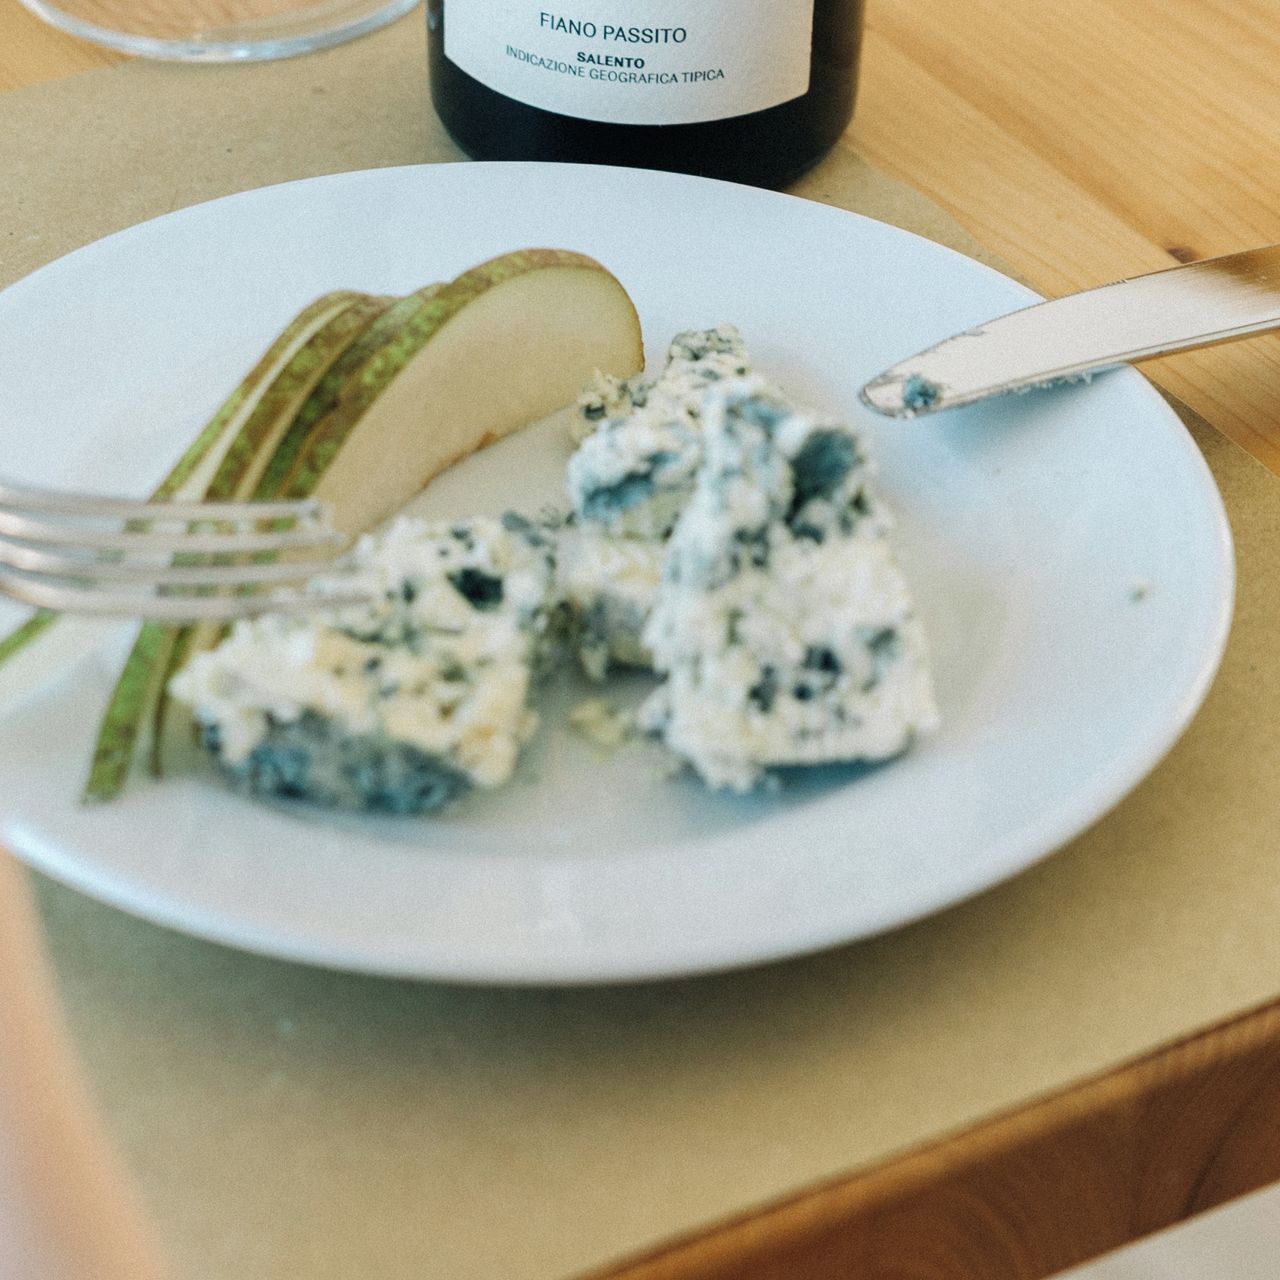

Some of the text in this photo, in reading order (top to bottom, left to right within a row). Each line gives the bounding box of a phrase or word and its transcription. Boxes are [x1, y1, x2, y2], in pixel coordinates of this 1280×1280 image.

[539, 11, 688, 45] FIANO PASSITO
[505, 44, 726, 85] INDICAZIONE GEOGRAFICA TIPICA
[576, 51, 646, 69] SALENTO
